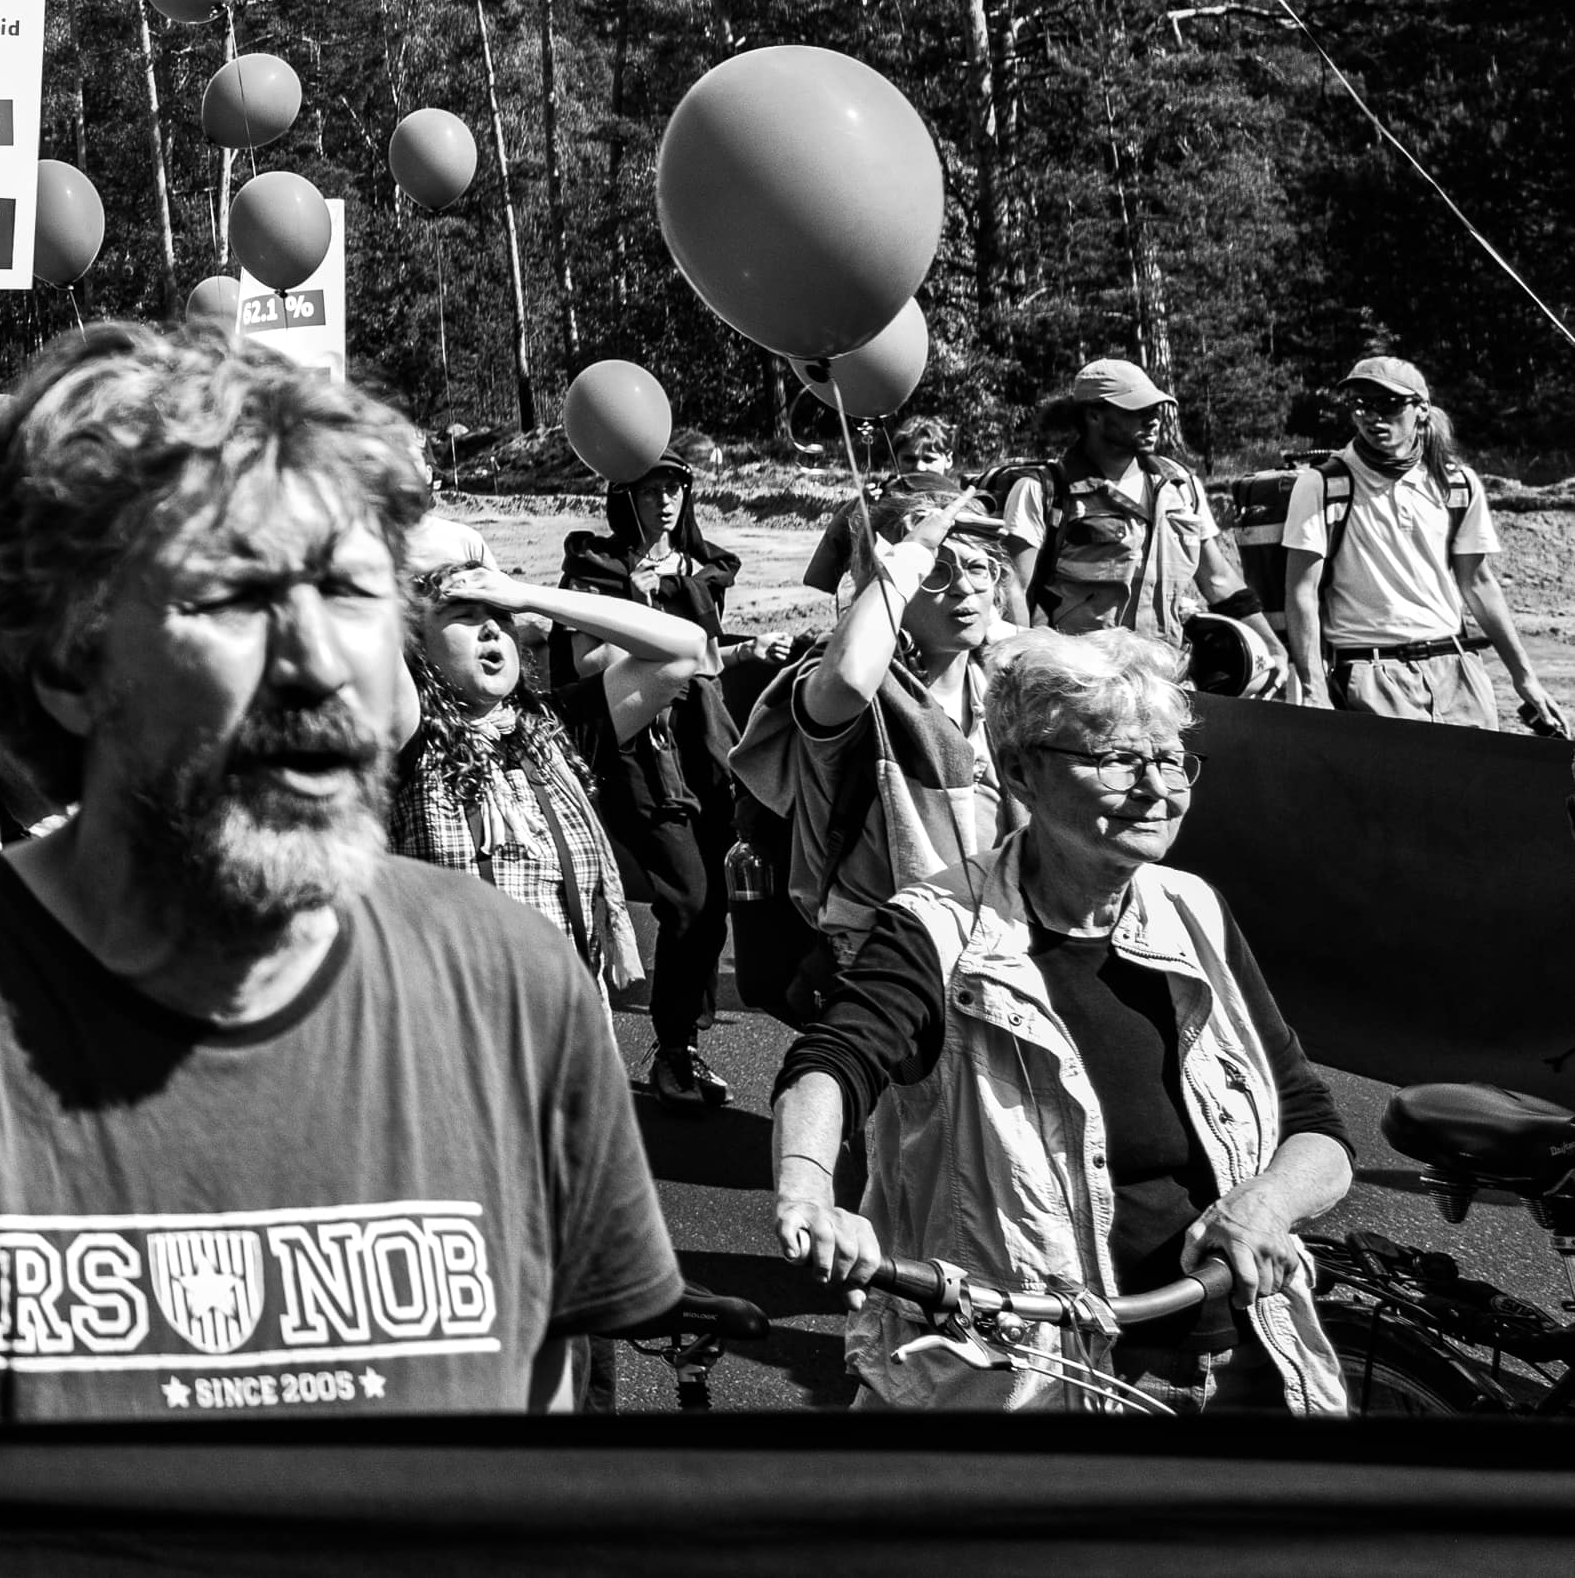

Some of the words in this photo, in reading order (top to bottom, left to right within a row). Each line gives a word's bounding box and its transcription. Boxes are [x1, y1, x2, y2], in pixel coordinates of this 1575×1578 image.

[242, 298, 278, 325] 62.1
[285, 295, 314, 318] %
[268, 1218, 496, 1345] NOB
[195, 1375, 278, 1409] SINCE
[280, 1371, 356, 1403] 2005
